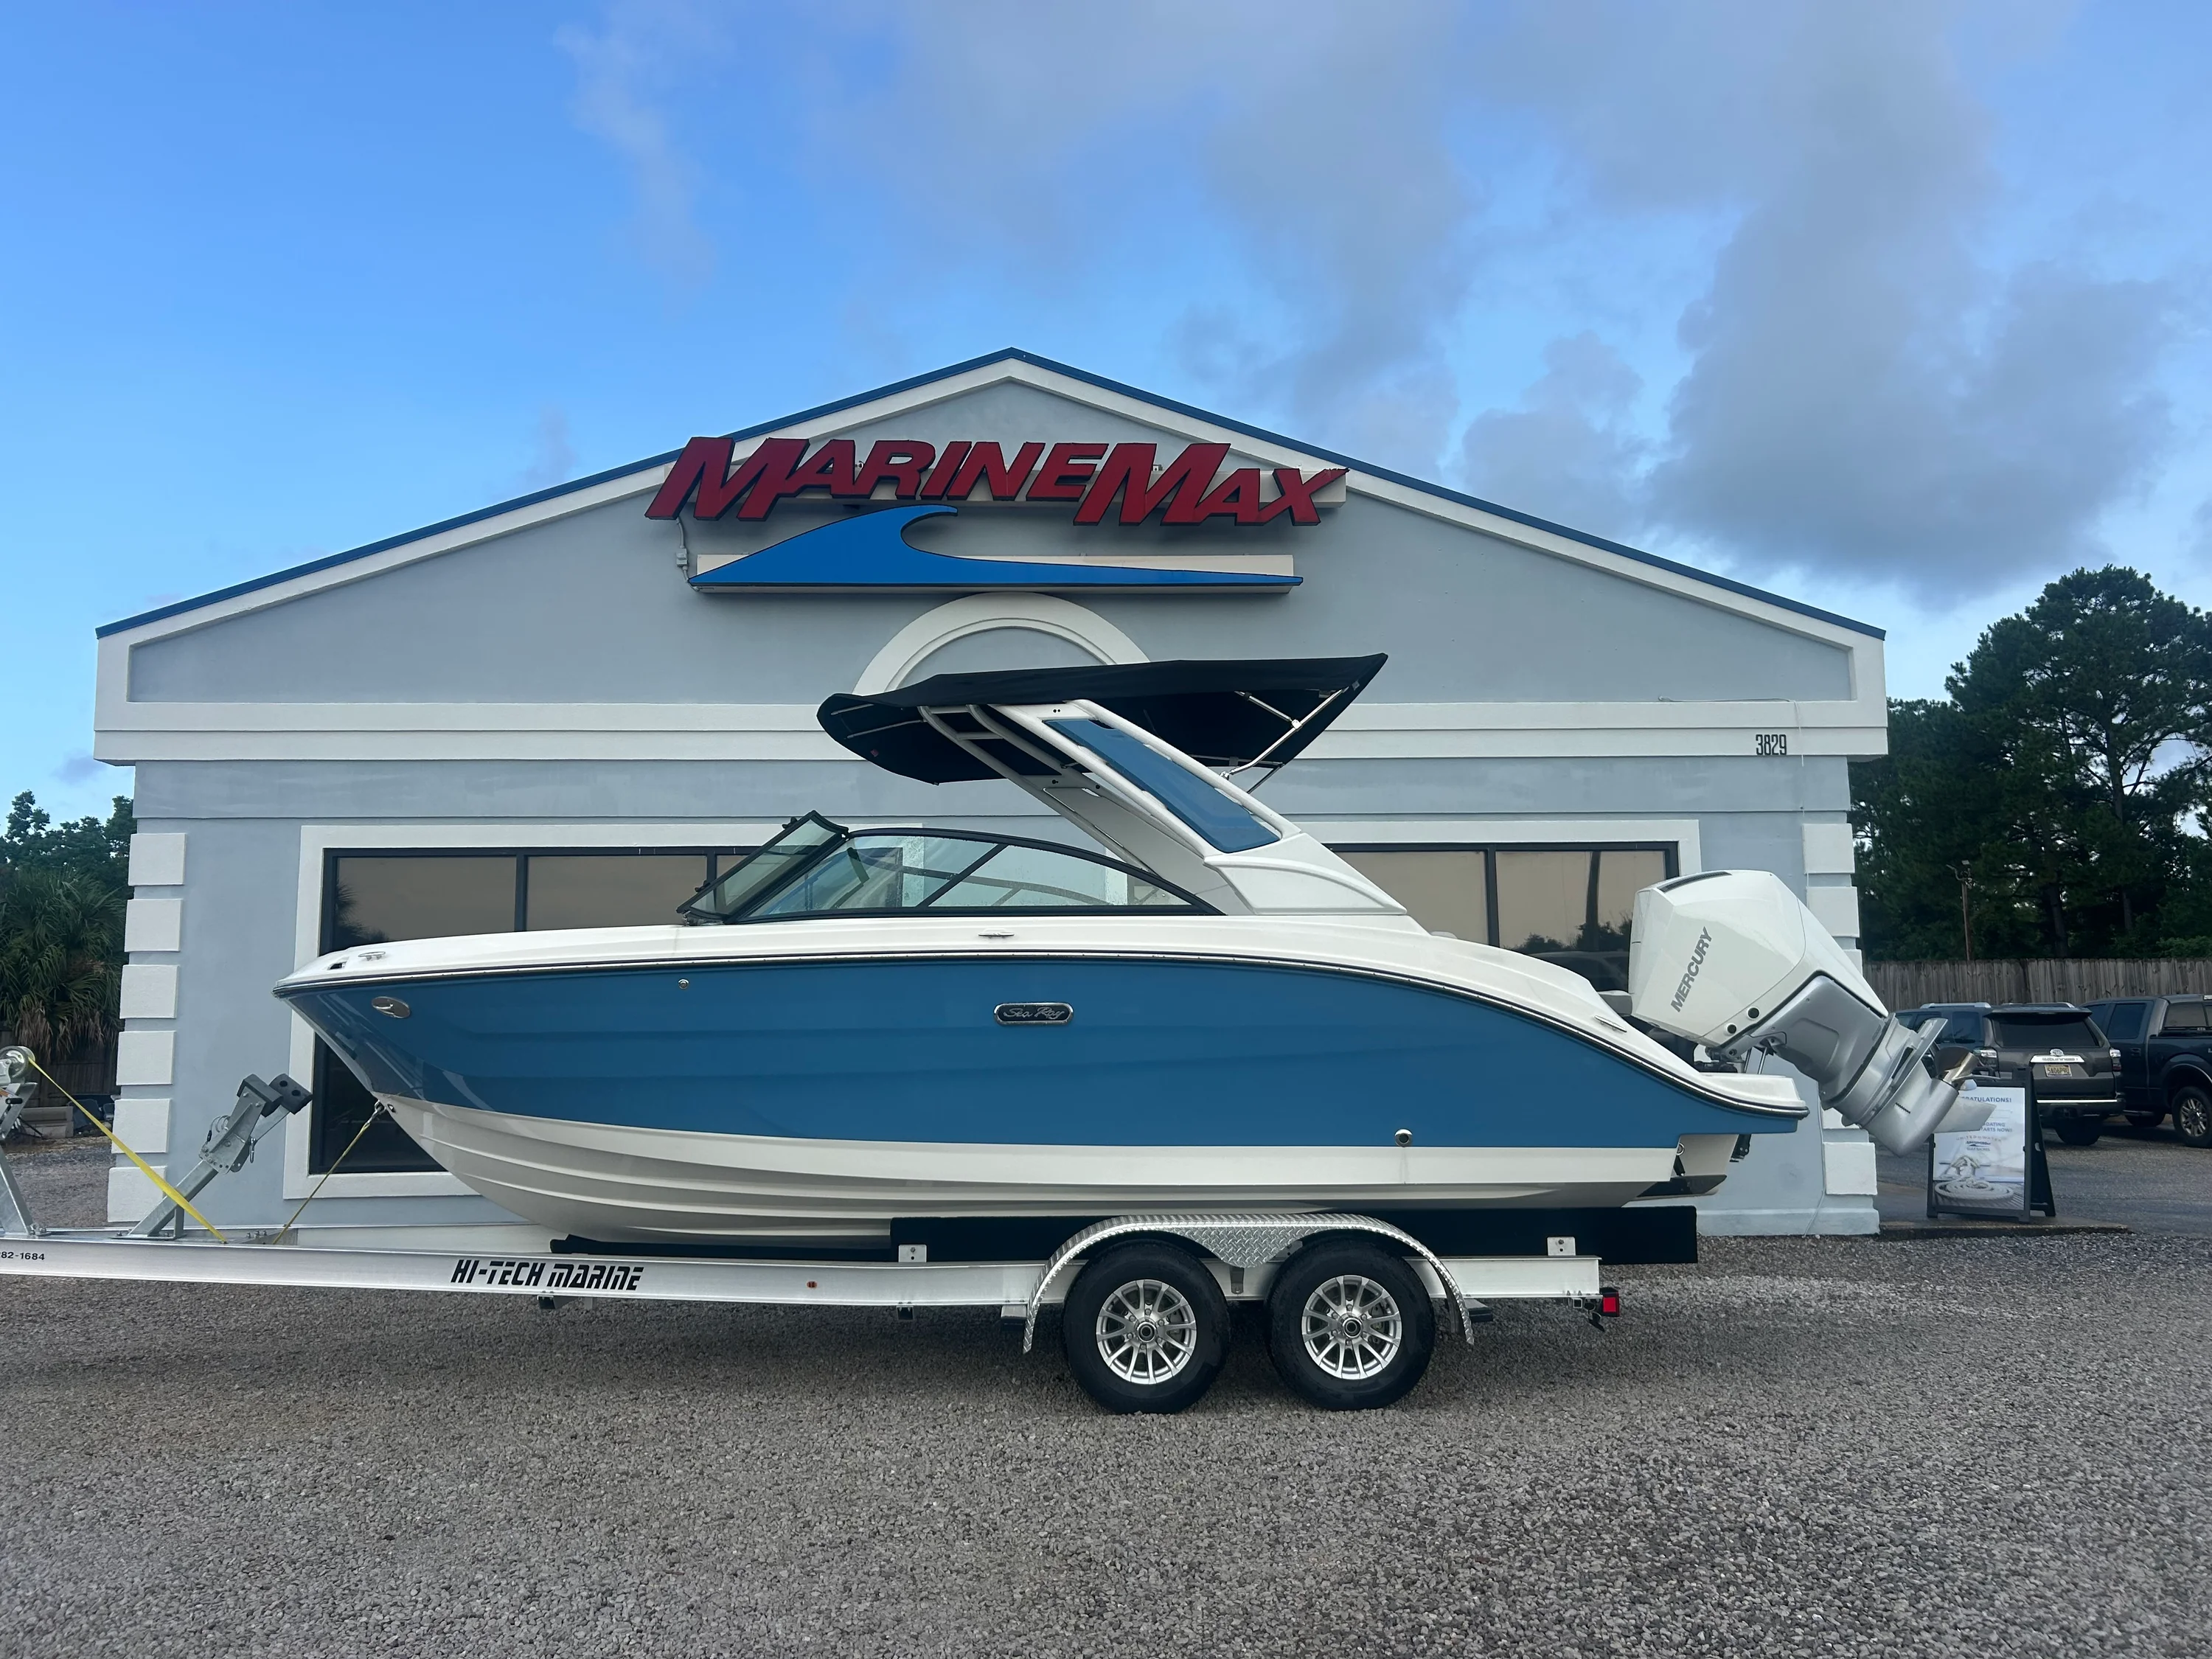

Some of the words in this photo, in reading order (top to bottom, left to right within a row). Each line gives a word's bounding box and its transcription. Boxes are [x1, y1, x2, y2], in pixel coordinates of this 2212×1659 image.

[1756, 734, 1787, 756] 3829
[1671, 926, 1712, 1012] MERCURY
[1003, 1007, 1032, 1018] Sea
[1034, 1006, 1065, 1020] Ray
[0, 1251, 45, 1261] 82-1684
[451, 1259, 546, 1286] HI-TECH
[546, 1263, 644, 1290] MARINE
